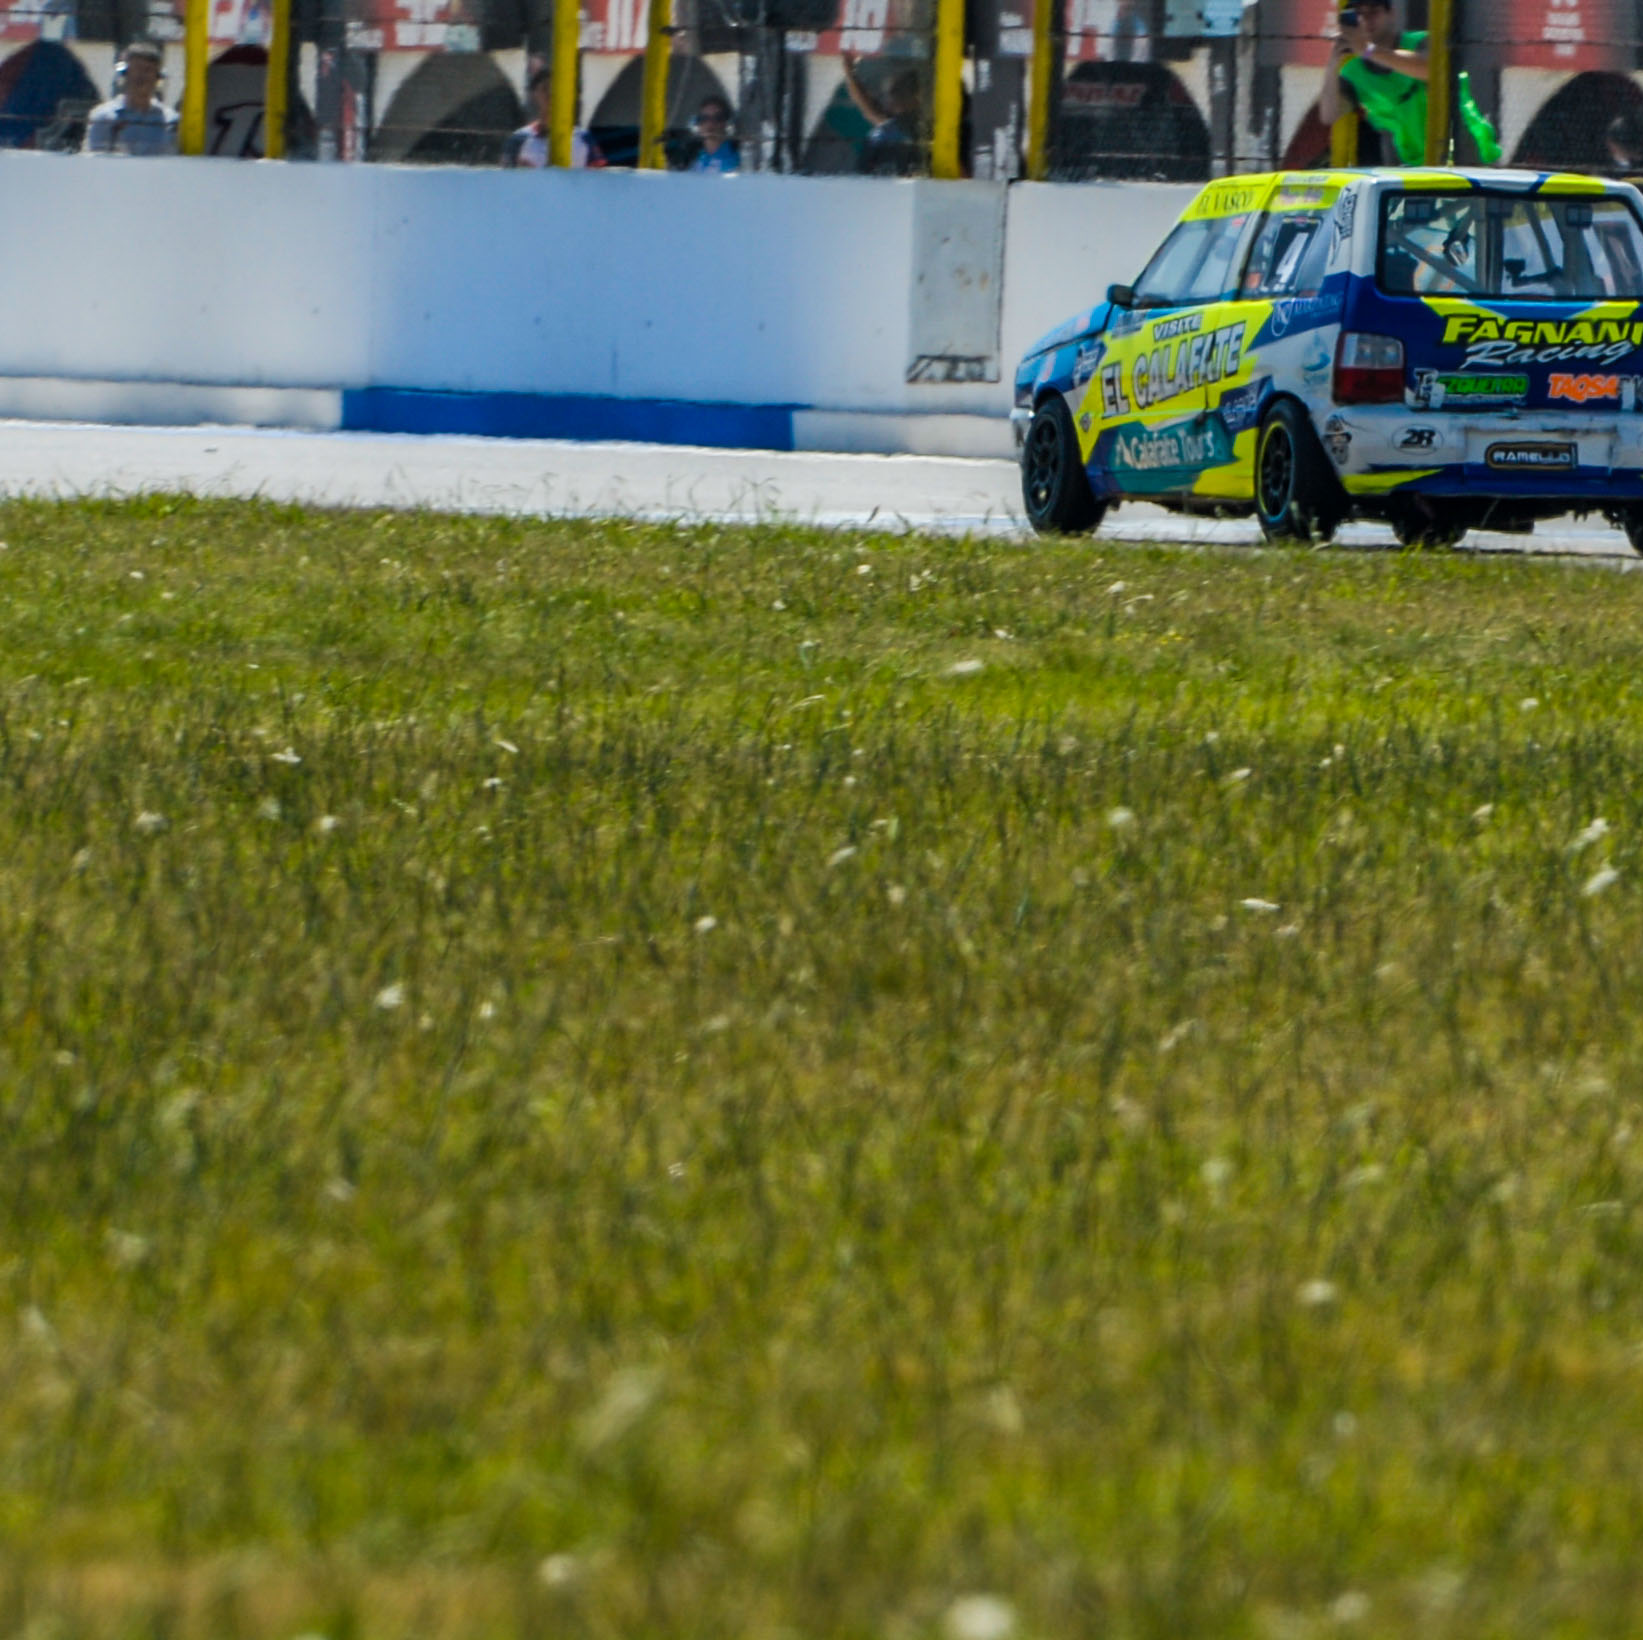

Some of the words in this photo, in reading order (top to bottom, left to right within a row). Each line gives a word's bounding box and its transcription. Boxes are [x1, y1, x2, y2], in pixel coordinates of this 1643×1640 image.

[1153, 311, 1205, 342] VISITE
[1459, 339, 1636, 370] Racing
[1101, 362, 1131, 420] EL
